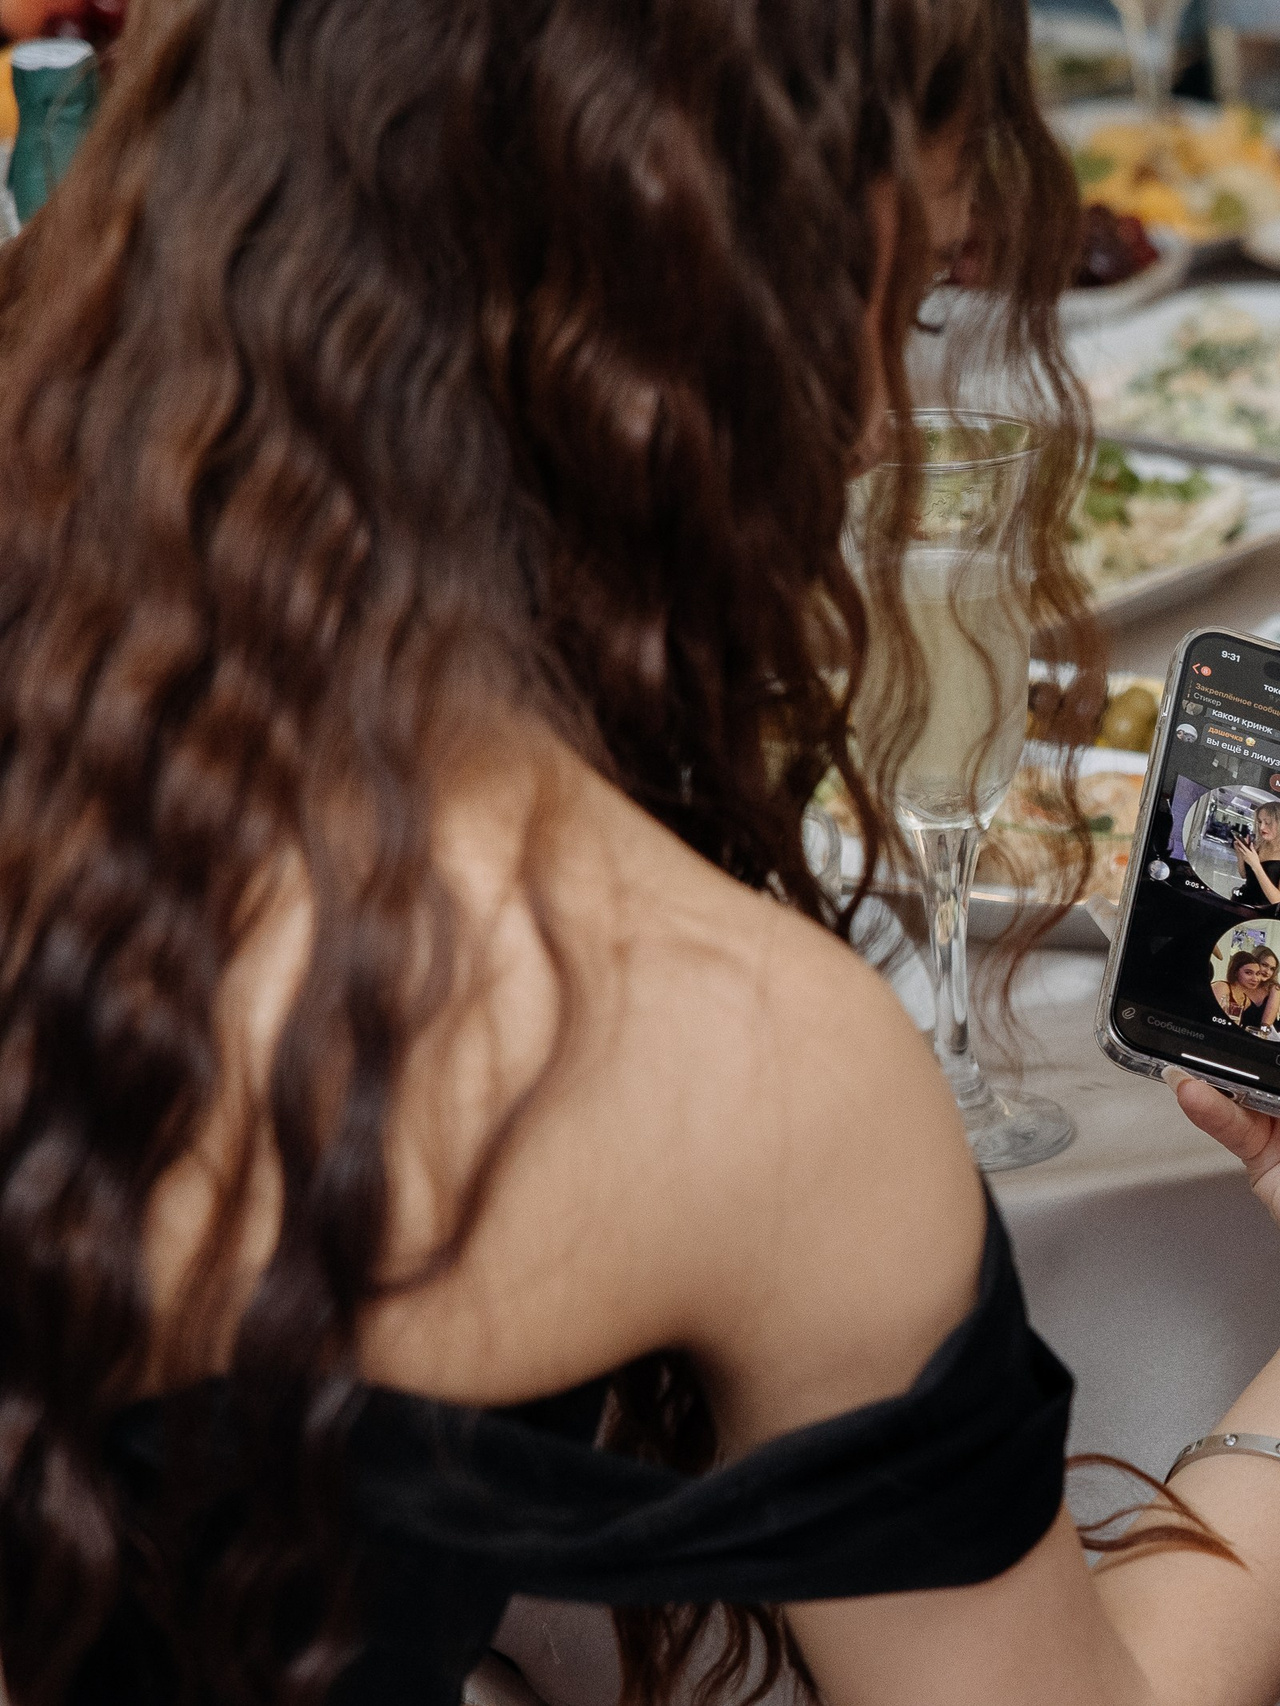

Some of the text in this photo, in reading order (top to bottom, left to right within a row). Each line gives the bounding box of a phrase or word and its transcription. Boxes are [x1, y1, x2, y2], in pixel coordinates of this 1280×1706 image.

[1221, 650, 1241, 662] 9:31
[1193, 692, 1222, 707] Стикер
[1195, 682, 1252, 706] Закреплённое
[1241, 718, 1273, 735] кринж
[1206, 737, 1219, 747] вы
[1221, 742, 1242, 754] ещё
[1185, 879, 1200, 889] 0:05
[1147, 1015, 1205, 1041] Сообщение
[1211, 1016, 1227, 1026] 0:05
